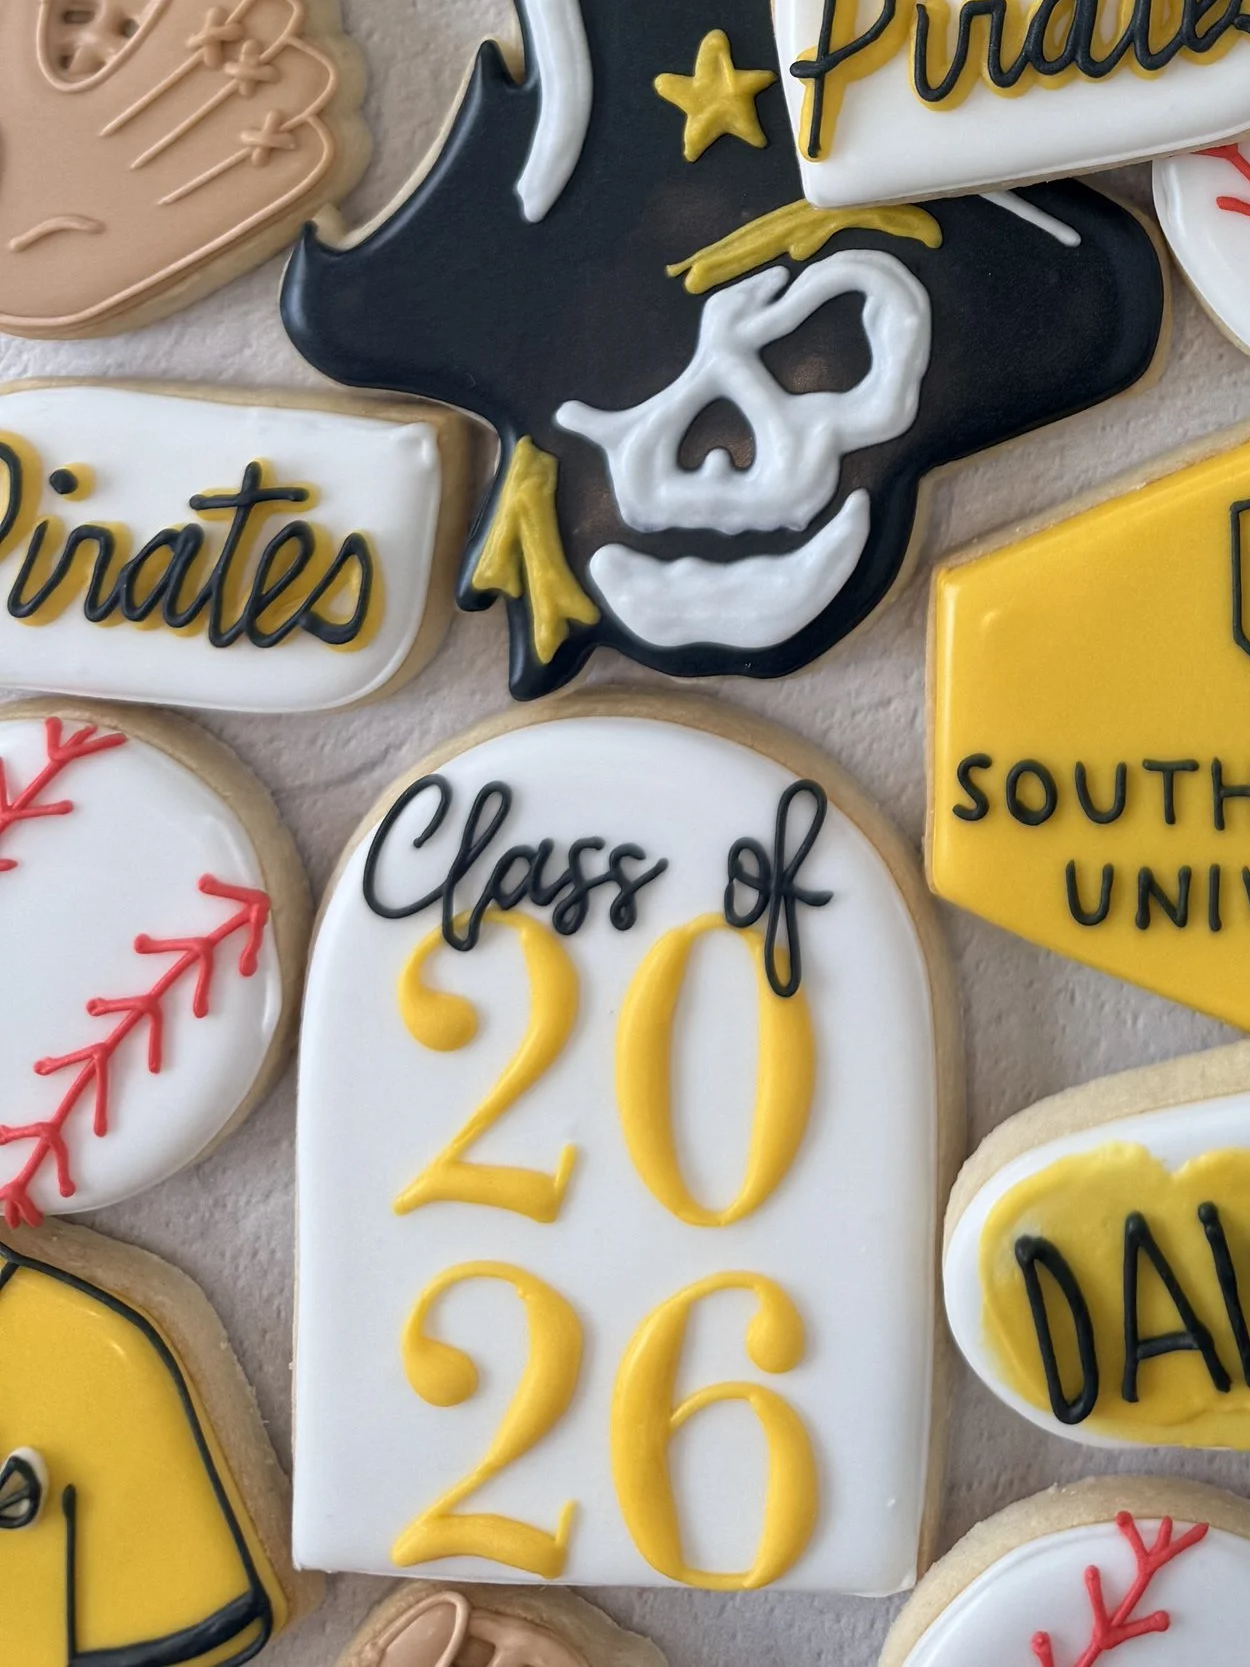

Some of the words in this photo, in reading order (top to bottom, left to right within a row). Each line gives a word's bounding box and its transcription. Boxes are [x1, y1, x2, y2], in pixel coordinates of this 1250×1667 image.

[362, 774, 668, 952] Class
[723, 778, 834, 998] of
[392, 912, 817, 1227] 20
[391, 1260, 819, 1592] 26
